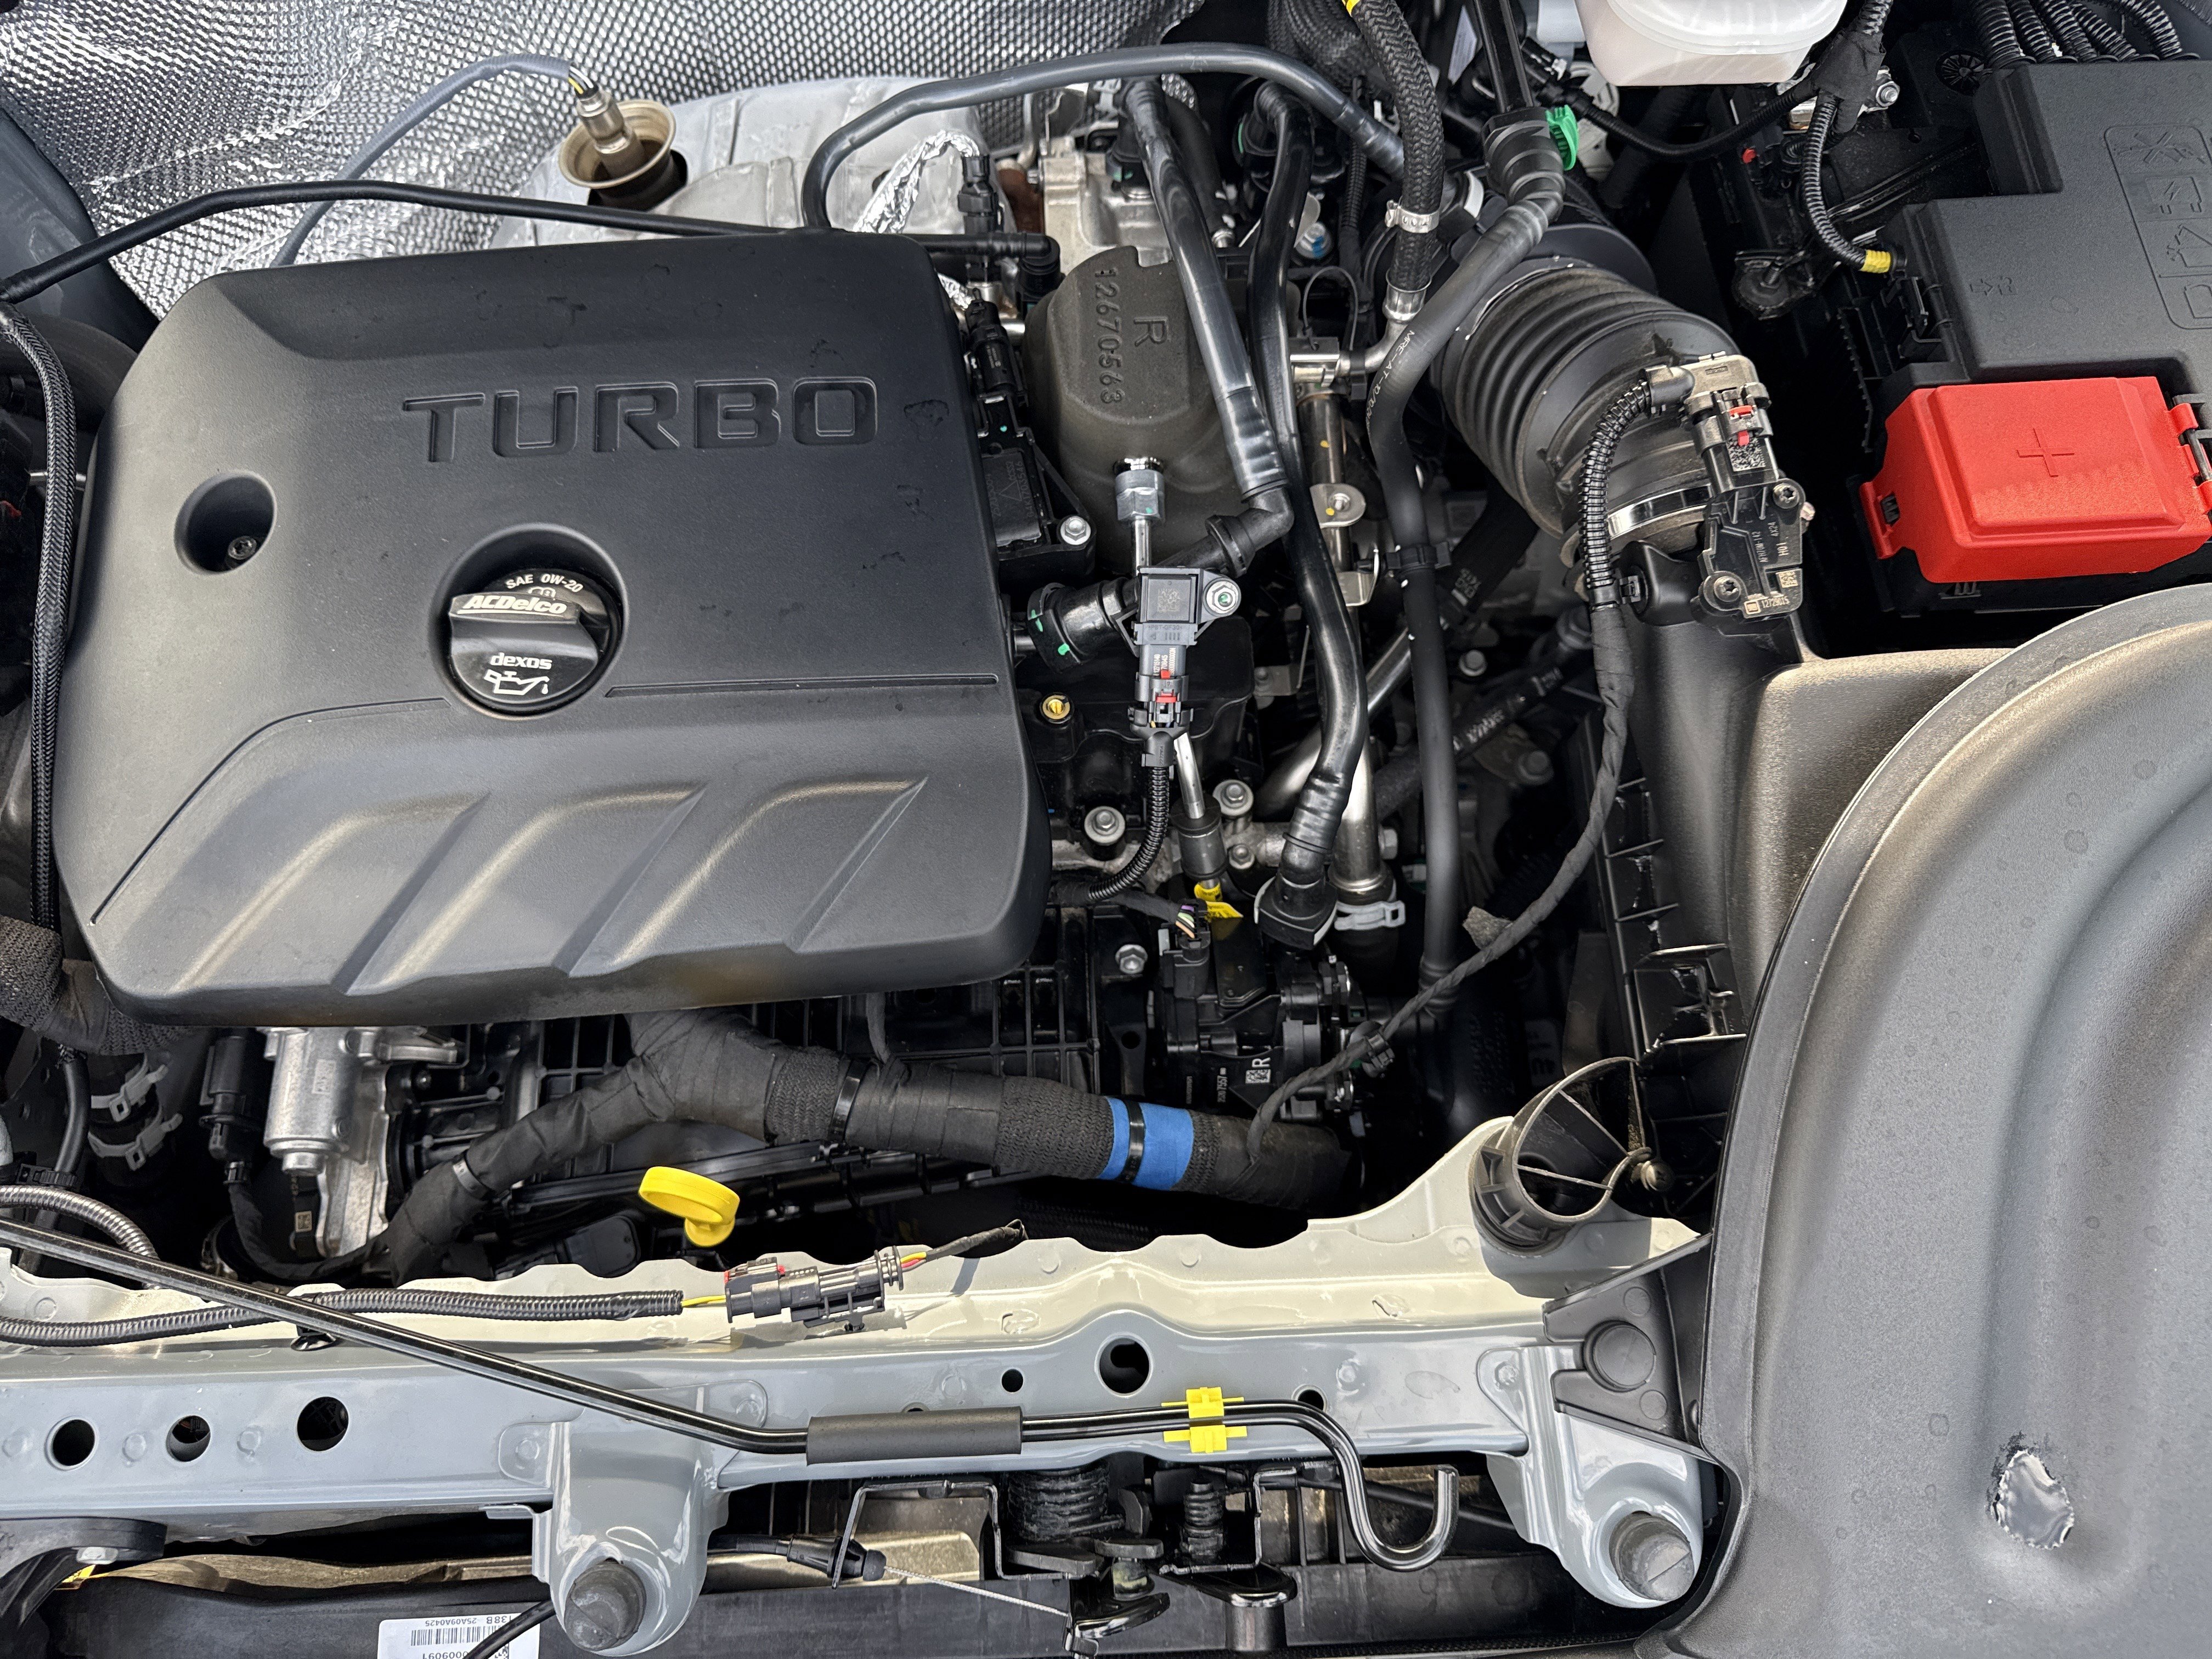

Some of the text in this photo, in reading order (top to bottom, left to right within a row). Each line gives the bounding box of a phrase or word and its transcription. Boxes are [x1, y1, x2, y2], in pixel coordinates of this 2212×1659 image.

[1095, 267, 1125, 404] 12670563
[1133, 316, 1171, 347] R
[403, 375, 878, 462] TURBO
[505, 573, 584, 592] SAE 0W-20
[462, 595, 567, 614] ACDelco
[490, 652, 552, 670] dexos
[1252, 1057, 1271, 1068] R
[425, 1617, 477, 1627] 25A09A0425
